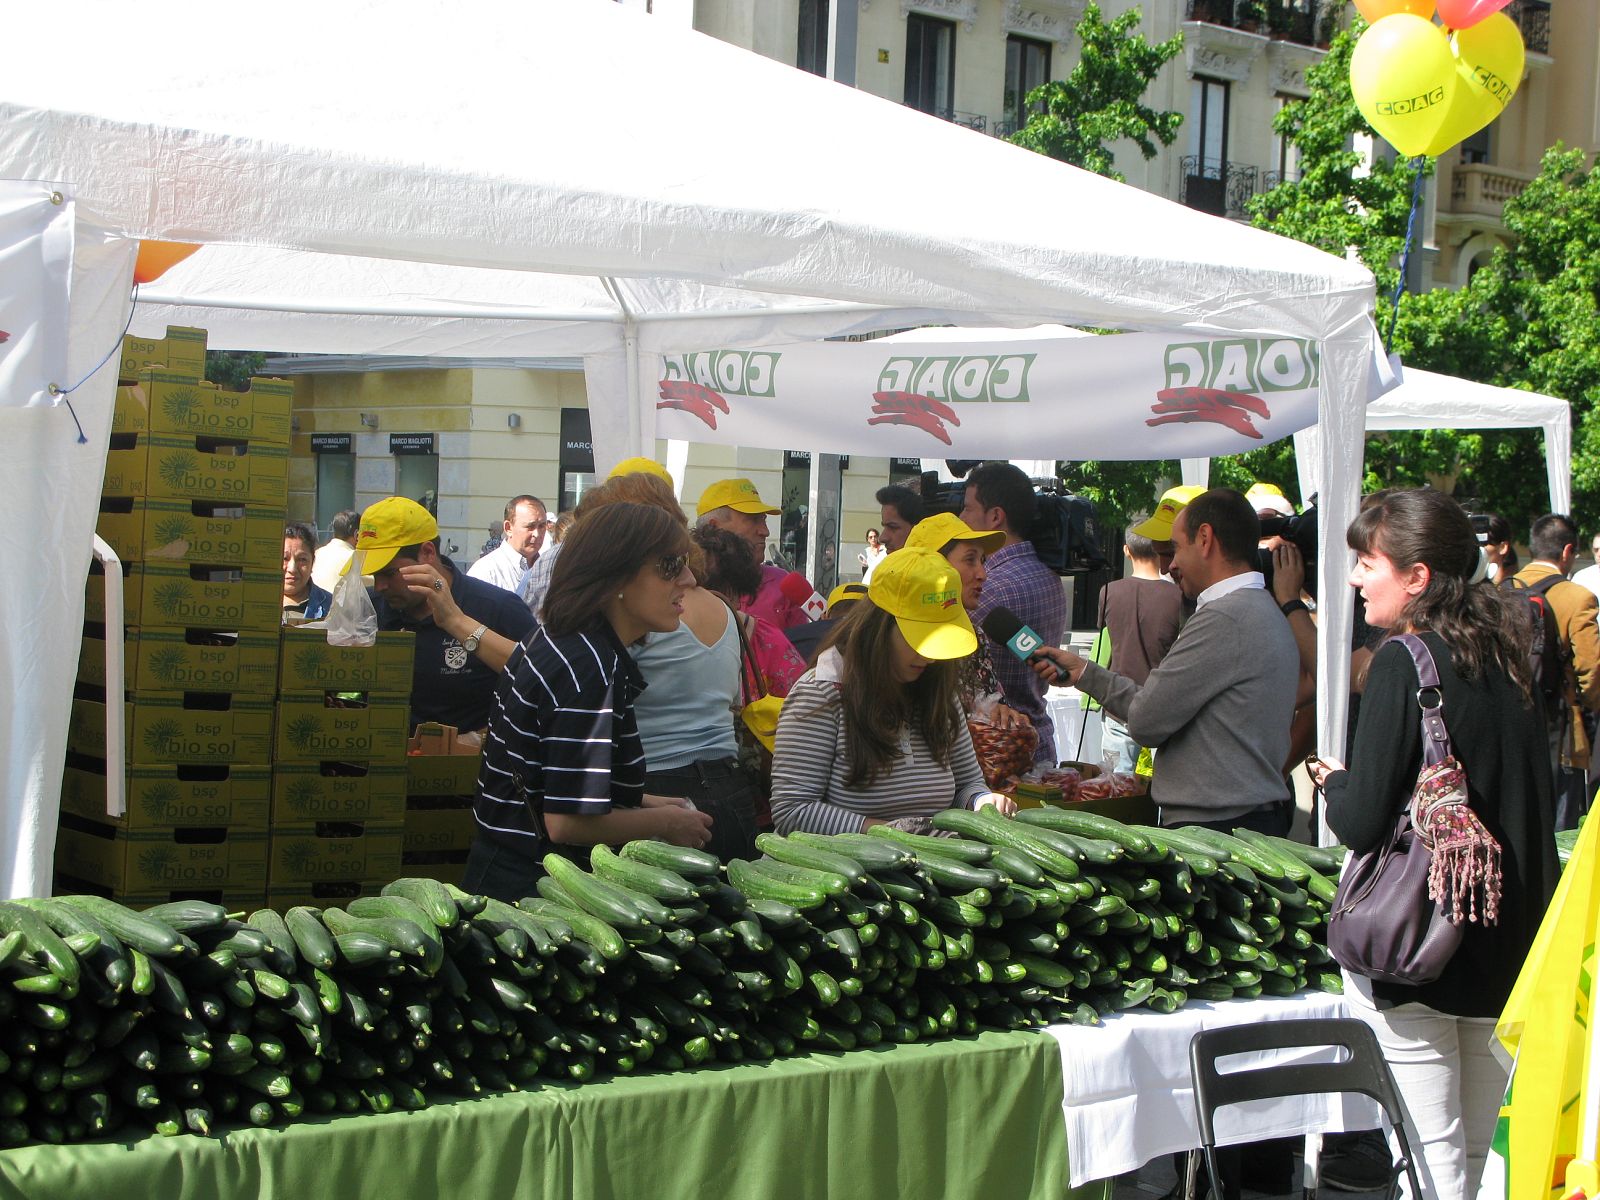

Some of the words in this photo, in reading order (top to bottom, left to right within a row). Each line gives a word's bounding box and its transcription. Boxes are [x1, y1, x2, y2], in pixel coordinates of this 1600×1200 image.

[1375, 86, 1444, 116] COAG
[131, 340, 156, 353] bsp
[214, 393, 239, 408] bsp
[188, 408, 219, 426] bio
[225, 414, 255, 431] sol
[210, 456, 236, 471] bsp
[185, 472, 216, 489] bio
[222, 477, 250, 491] sol
[206, 520, 232, 535] bsp
[218, 540, 246, 556] sol
[203, 584, 230, 599] bsp
[178, 600, 210, 618] bio
[215, 604, 244, 618] sol
[200, 649, 226, 664] bsp
[340, 649, 365, 662] bsp
[174, 665, 206, 682] bio
[212, 669, 240, 683] sol
[316, 664, 346, 681] bio
[352, 665, 378, 681] sol
[195, 722, 221, 736] bsp
[334, 718, 359, 731] bsp
[169, 738, 201, 754] bio
[206, 740, 236, 754] sol
[308, 733, 340, 749] bio
[345, 734, 373, 749] sol
[333, 780, 358, 793] bsp
[432, 776, 457, 788] sol
[192, 785, 218, 798] bsp
[166, 801, 198, 818] bio
[202, 803, 232, 818] sol
[308, 796, 339, 811] bio
[345, 797, 371, 811] sol
[430, 831, 455, 845] sol
[189, 848, 216, 860] bsp
[329, 842, 353, 854] bsp
[163, 863, 195, 879] bio
[200, 865, 230, 879] sol
[304, 858, 335, 873] bio
[340, 858, 367, 873] sol
